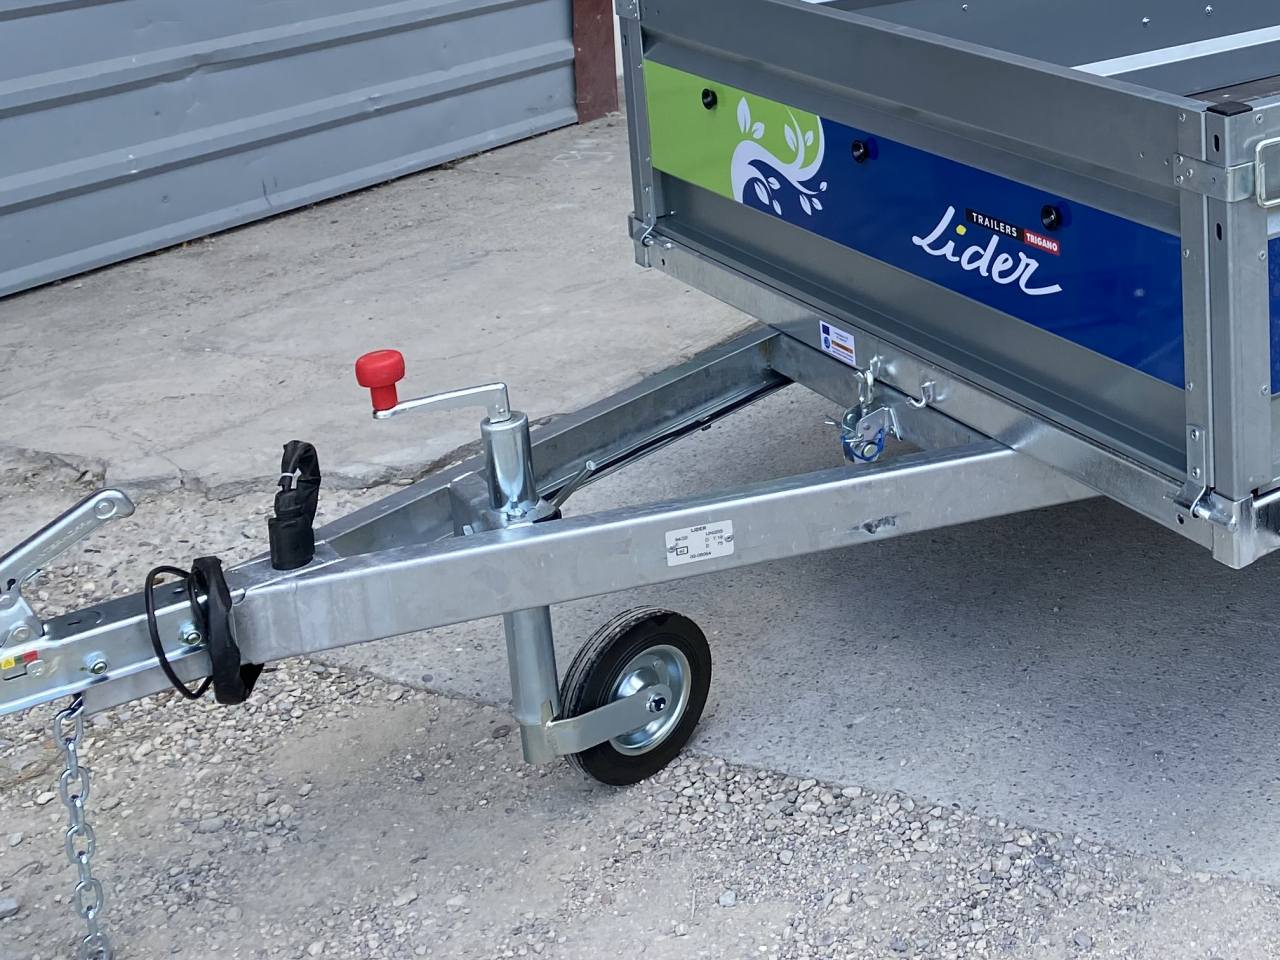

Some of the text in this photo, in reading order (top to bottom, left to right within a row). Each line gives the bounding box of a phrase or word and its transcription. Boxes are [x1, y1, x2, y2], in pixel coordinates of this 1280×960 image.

[912, 206, 1062, 296] Lider
[972, 212, 1058, 252] TRAILERS TRIGANO
